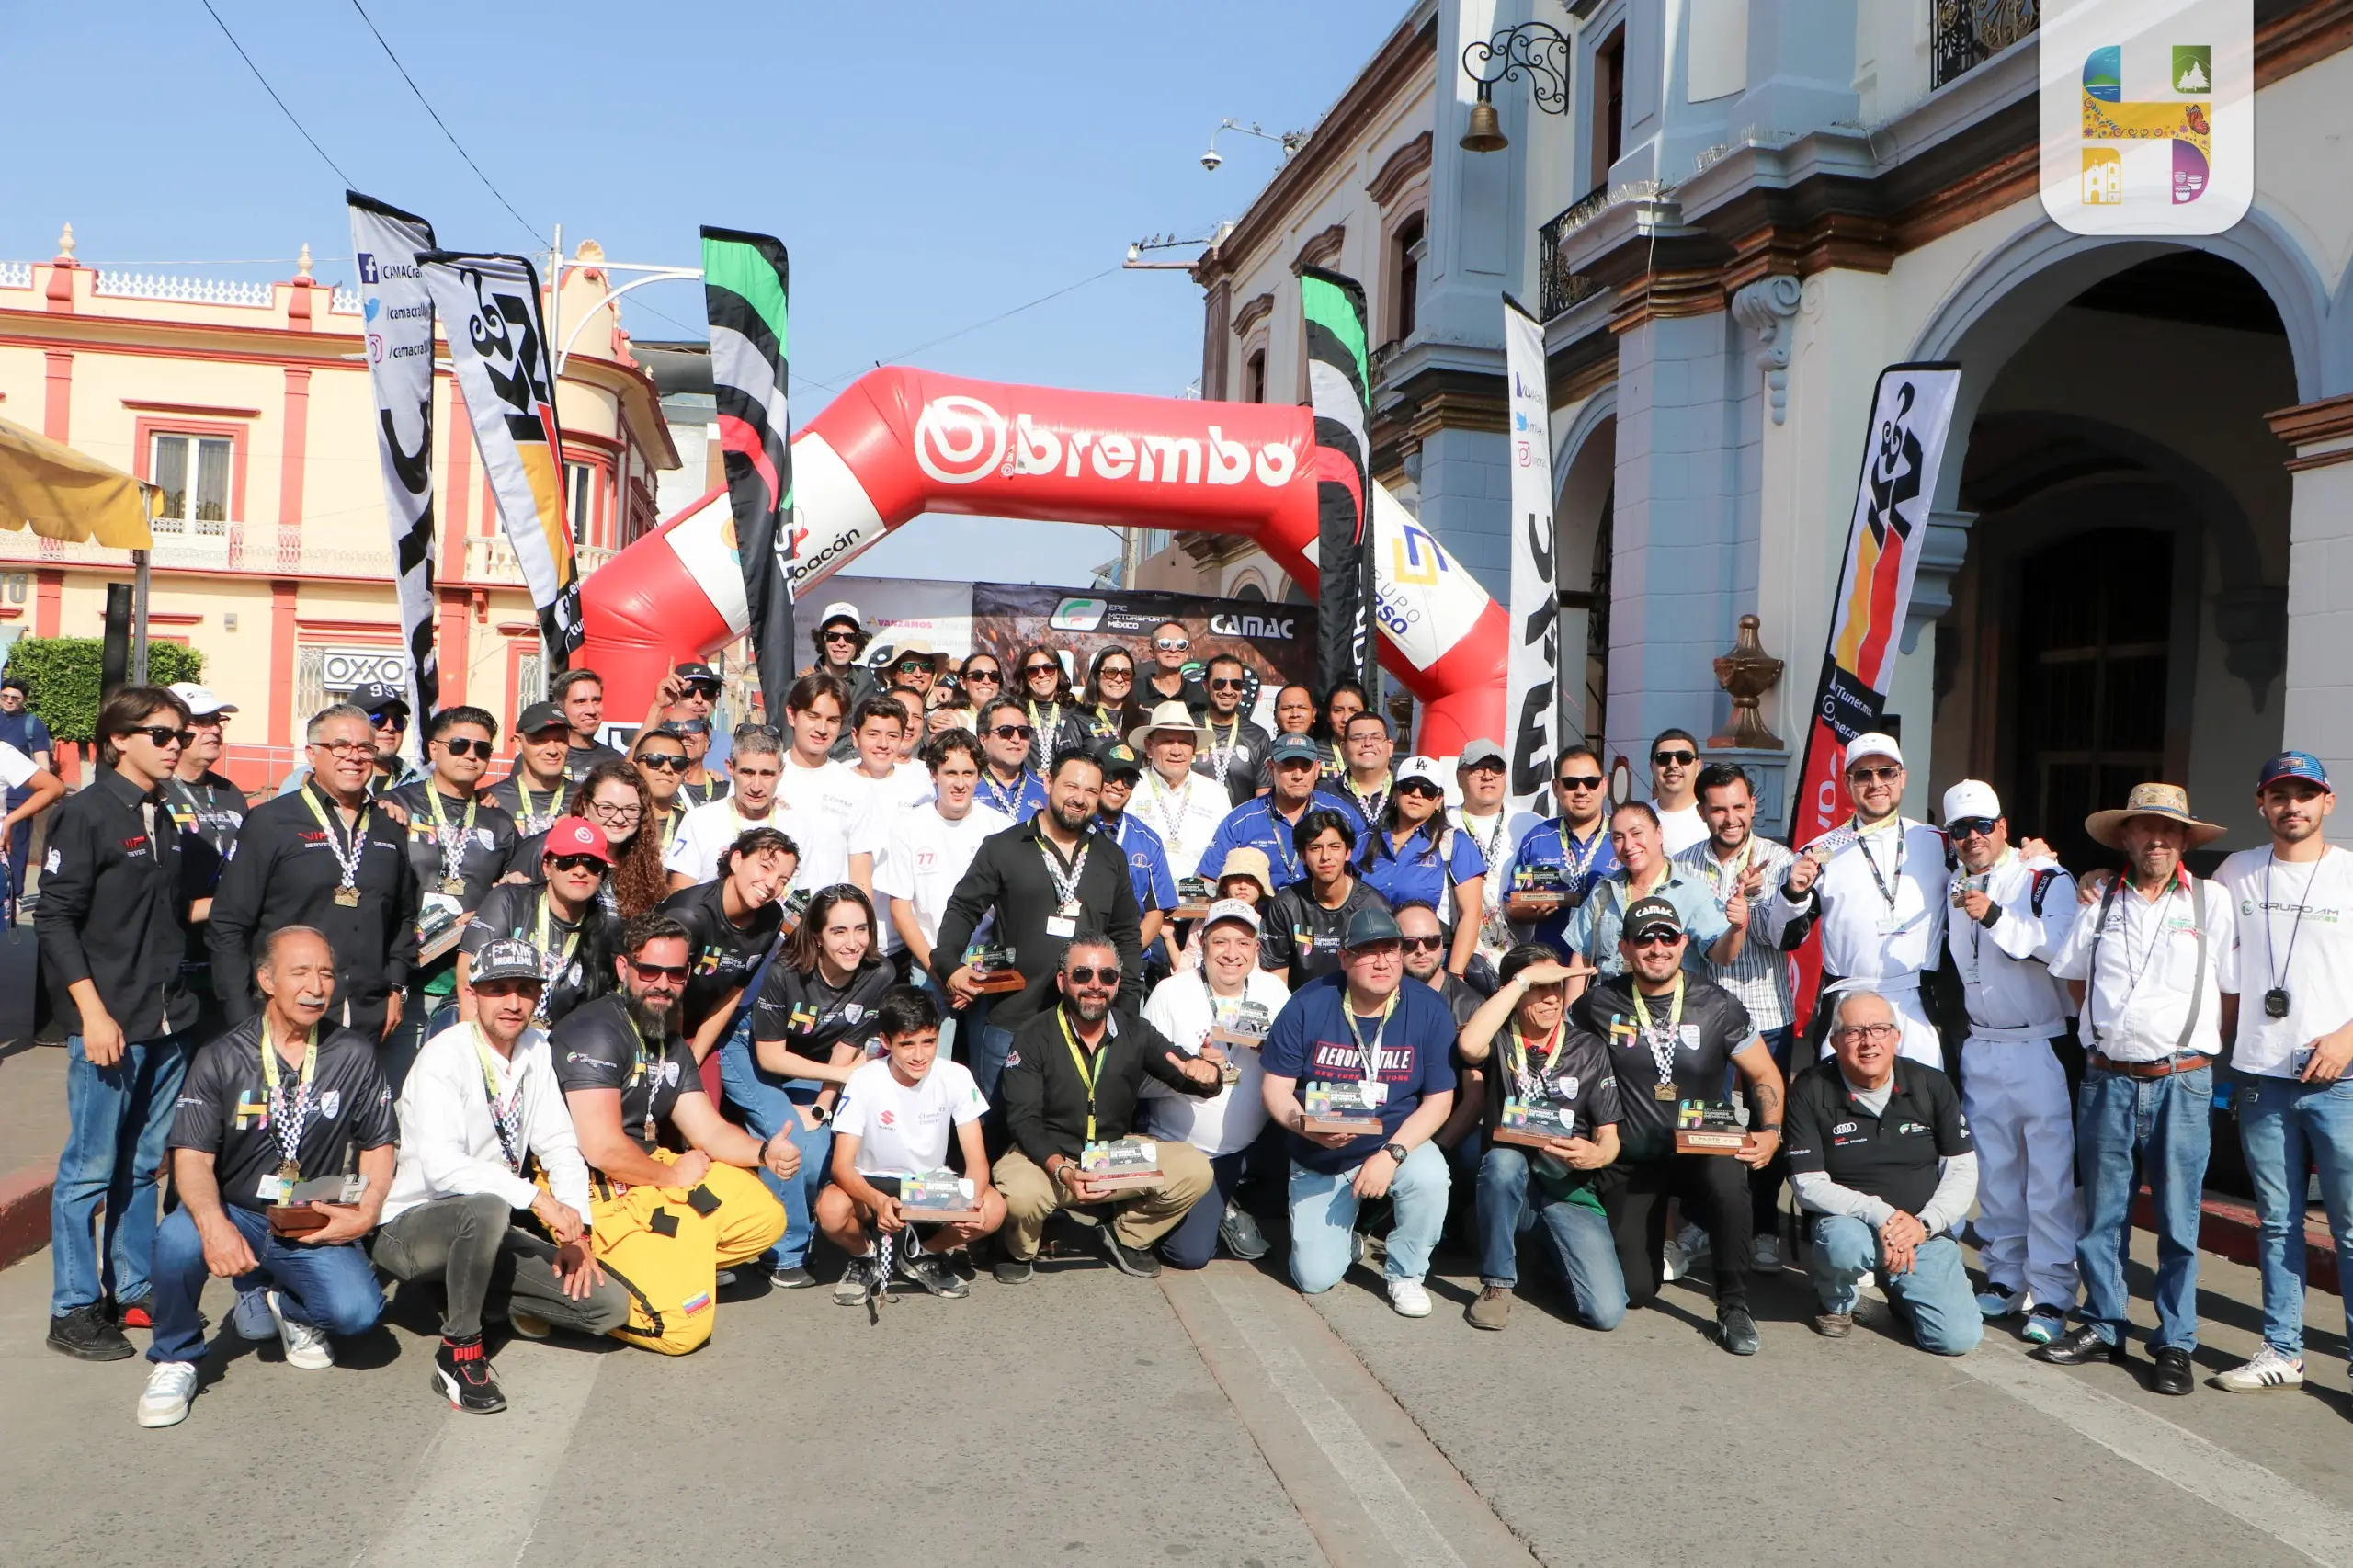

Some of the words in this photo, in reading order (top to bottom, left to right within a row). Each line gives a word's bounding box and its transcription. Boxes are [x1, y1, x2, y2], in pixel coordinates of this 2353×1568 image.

[1016, 413, 1296, 487] brembo
[794, 528, 860, 579] oacán
[1108, 604, 1127, 612] EPIC
[1108, 619, 1139, 630] MÉXICO
[1211, 614, 1294, 639] CAMAC
[327, 656, 404, 683] OXXO
[369, 683, 395, 698] 99
[917, 853, 934, 864] 77
[2033, 875, 2049, 903] sparco
[1635, 905, 1673, 918] CAMAC
[2258, 902, 2313, 914] GRUPO
[1316, 1046, 1411, 1069] AEROPTALE
